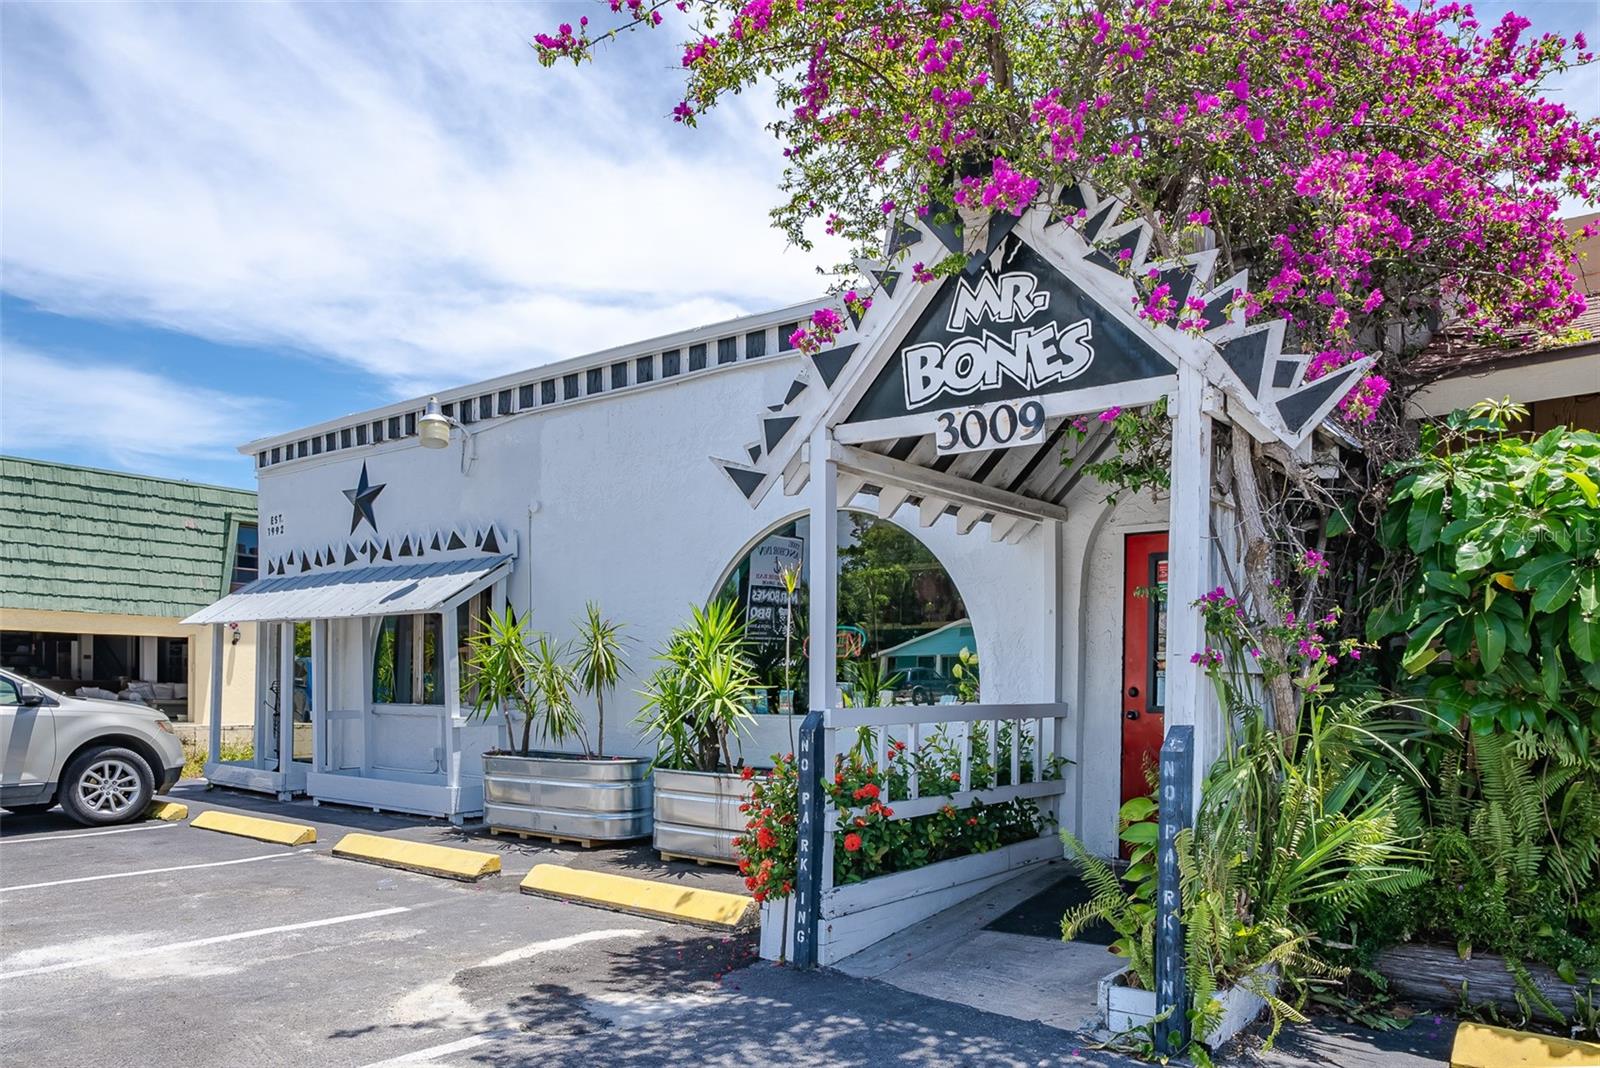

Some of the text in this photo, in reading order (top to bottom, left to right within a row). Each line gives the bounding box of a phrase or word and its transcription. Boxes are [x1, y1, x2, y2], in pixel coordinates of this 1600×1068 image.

[946, 270, 1050, 333] MR.
[902, 318, 1094, 410] BONES
[937, 401, 1045, 450] 3009
[268, 525, 284, 536] 1992
[271, 514, 283, 525] EST.
[801, 739, 810, 771] NO
[1163, 760, 1175, 801] NO
